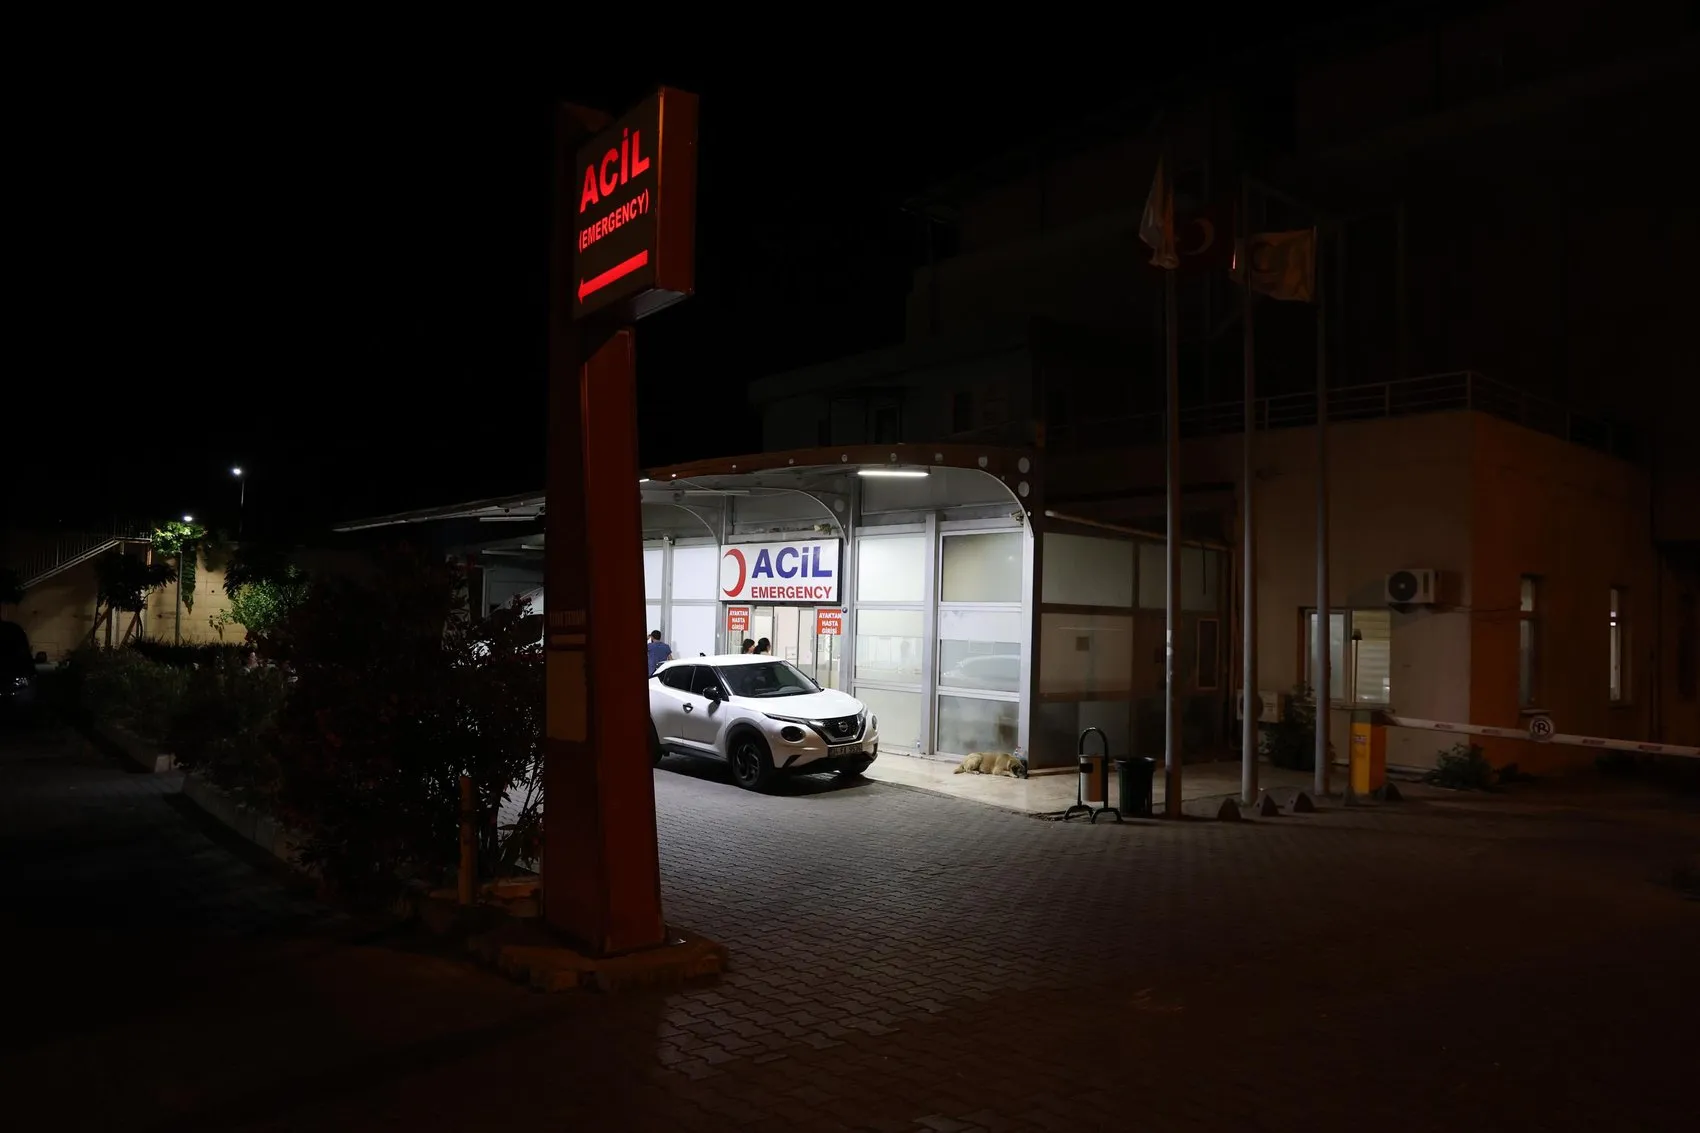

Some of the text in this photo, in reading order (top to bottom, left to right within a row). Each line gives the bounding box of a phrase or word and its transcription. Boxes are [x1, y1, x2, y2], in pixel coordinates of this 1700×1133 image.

[580, 128, 650, 213] ACİL
[579, 189, 649, 253] (EMERGENCY)
[751, 586, 832, 599] EMERGENCY
